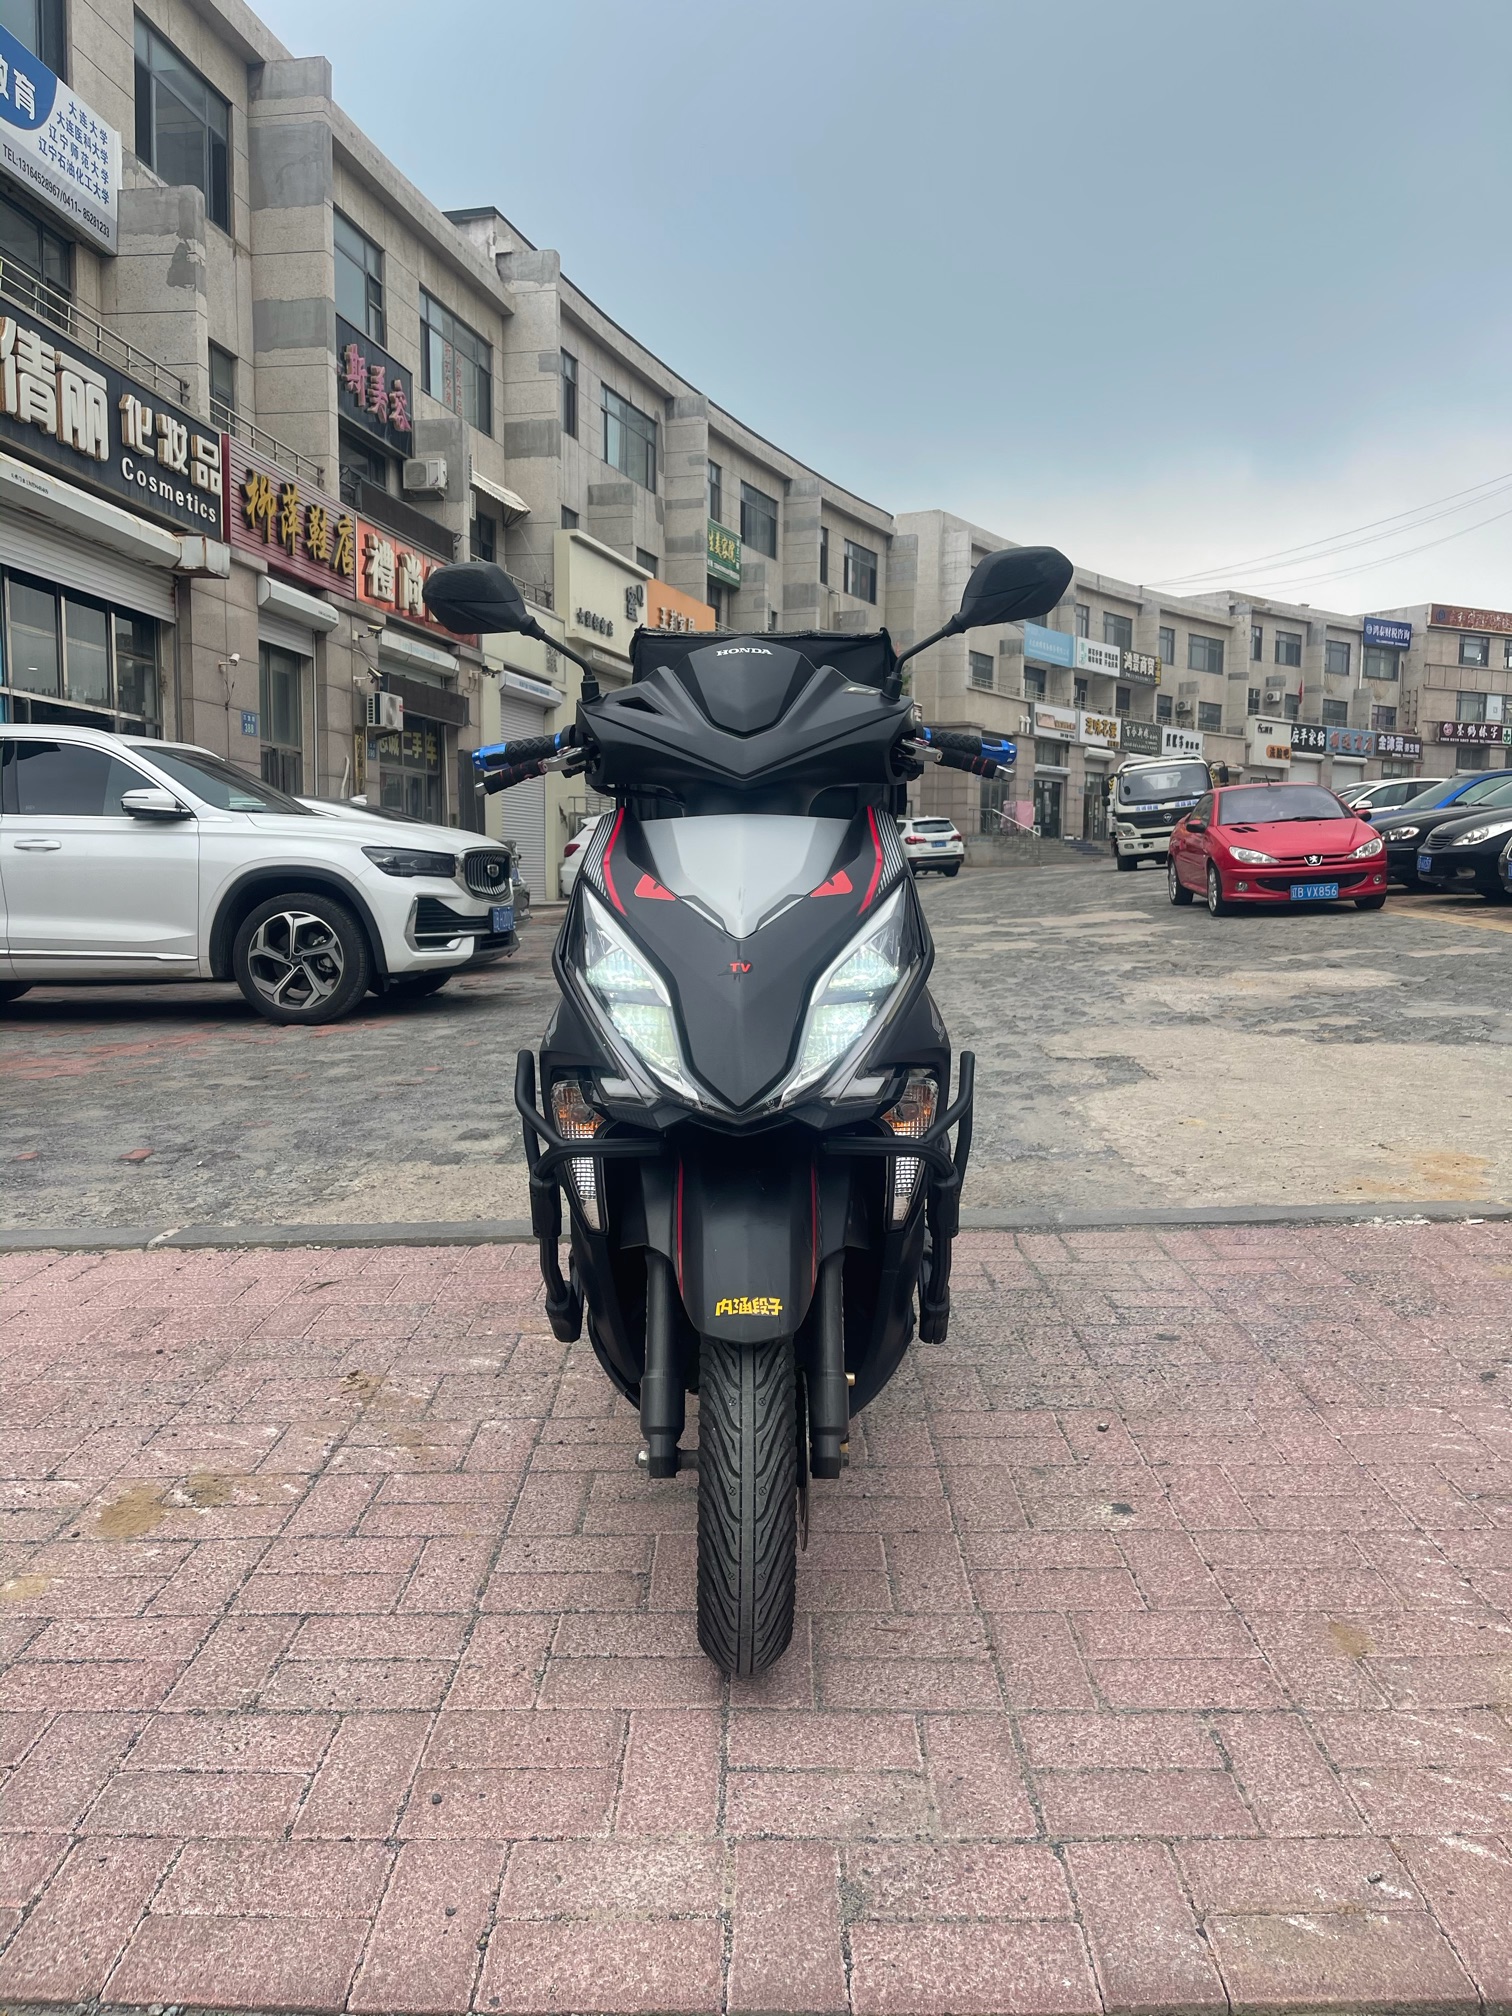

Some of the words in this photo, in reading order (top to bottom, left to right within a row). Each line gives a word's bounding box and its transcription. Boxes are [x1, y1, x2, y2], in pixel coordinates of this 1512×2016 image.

[57, 110, 108, 164] 大连医科大学
[69, 101, 108, 145] 大连大学
[39, 136, 109, 204] 辽宁石油化工大学
[49, 123, 109, 184] 辽宁师范大学
[121, 457, 217, 523] Cosmetics
[716, 647, 773, 657] HONDA
[729, 962, 751, 973] TV
[715, 1296, 783, 1316] 内涵段子
